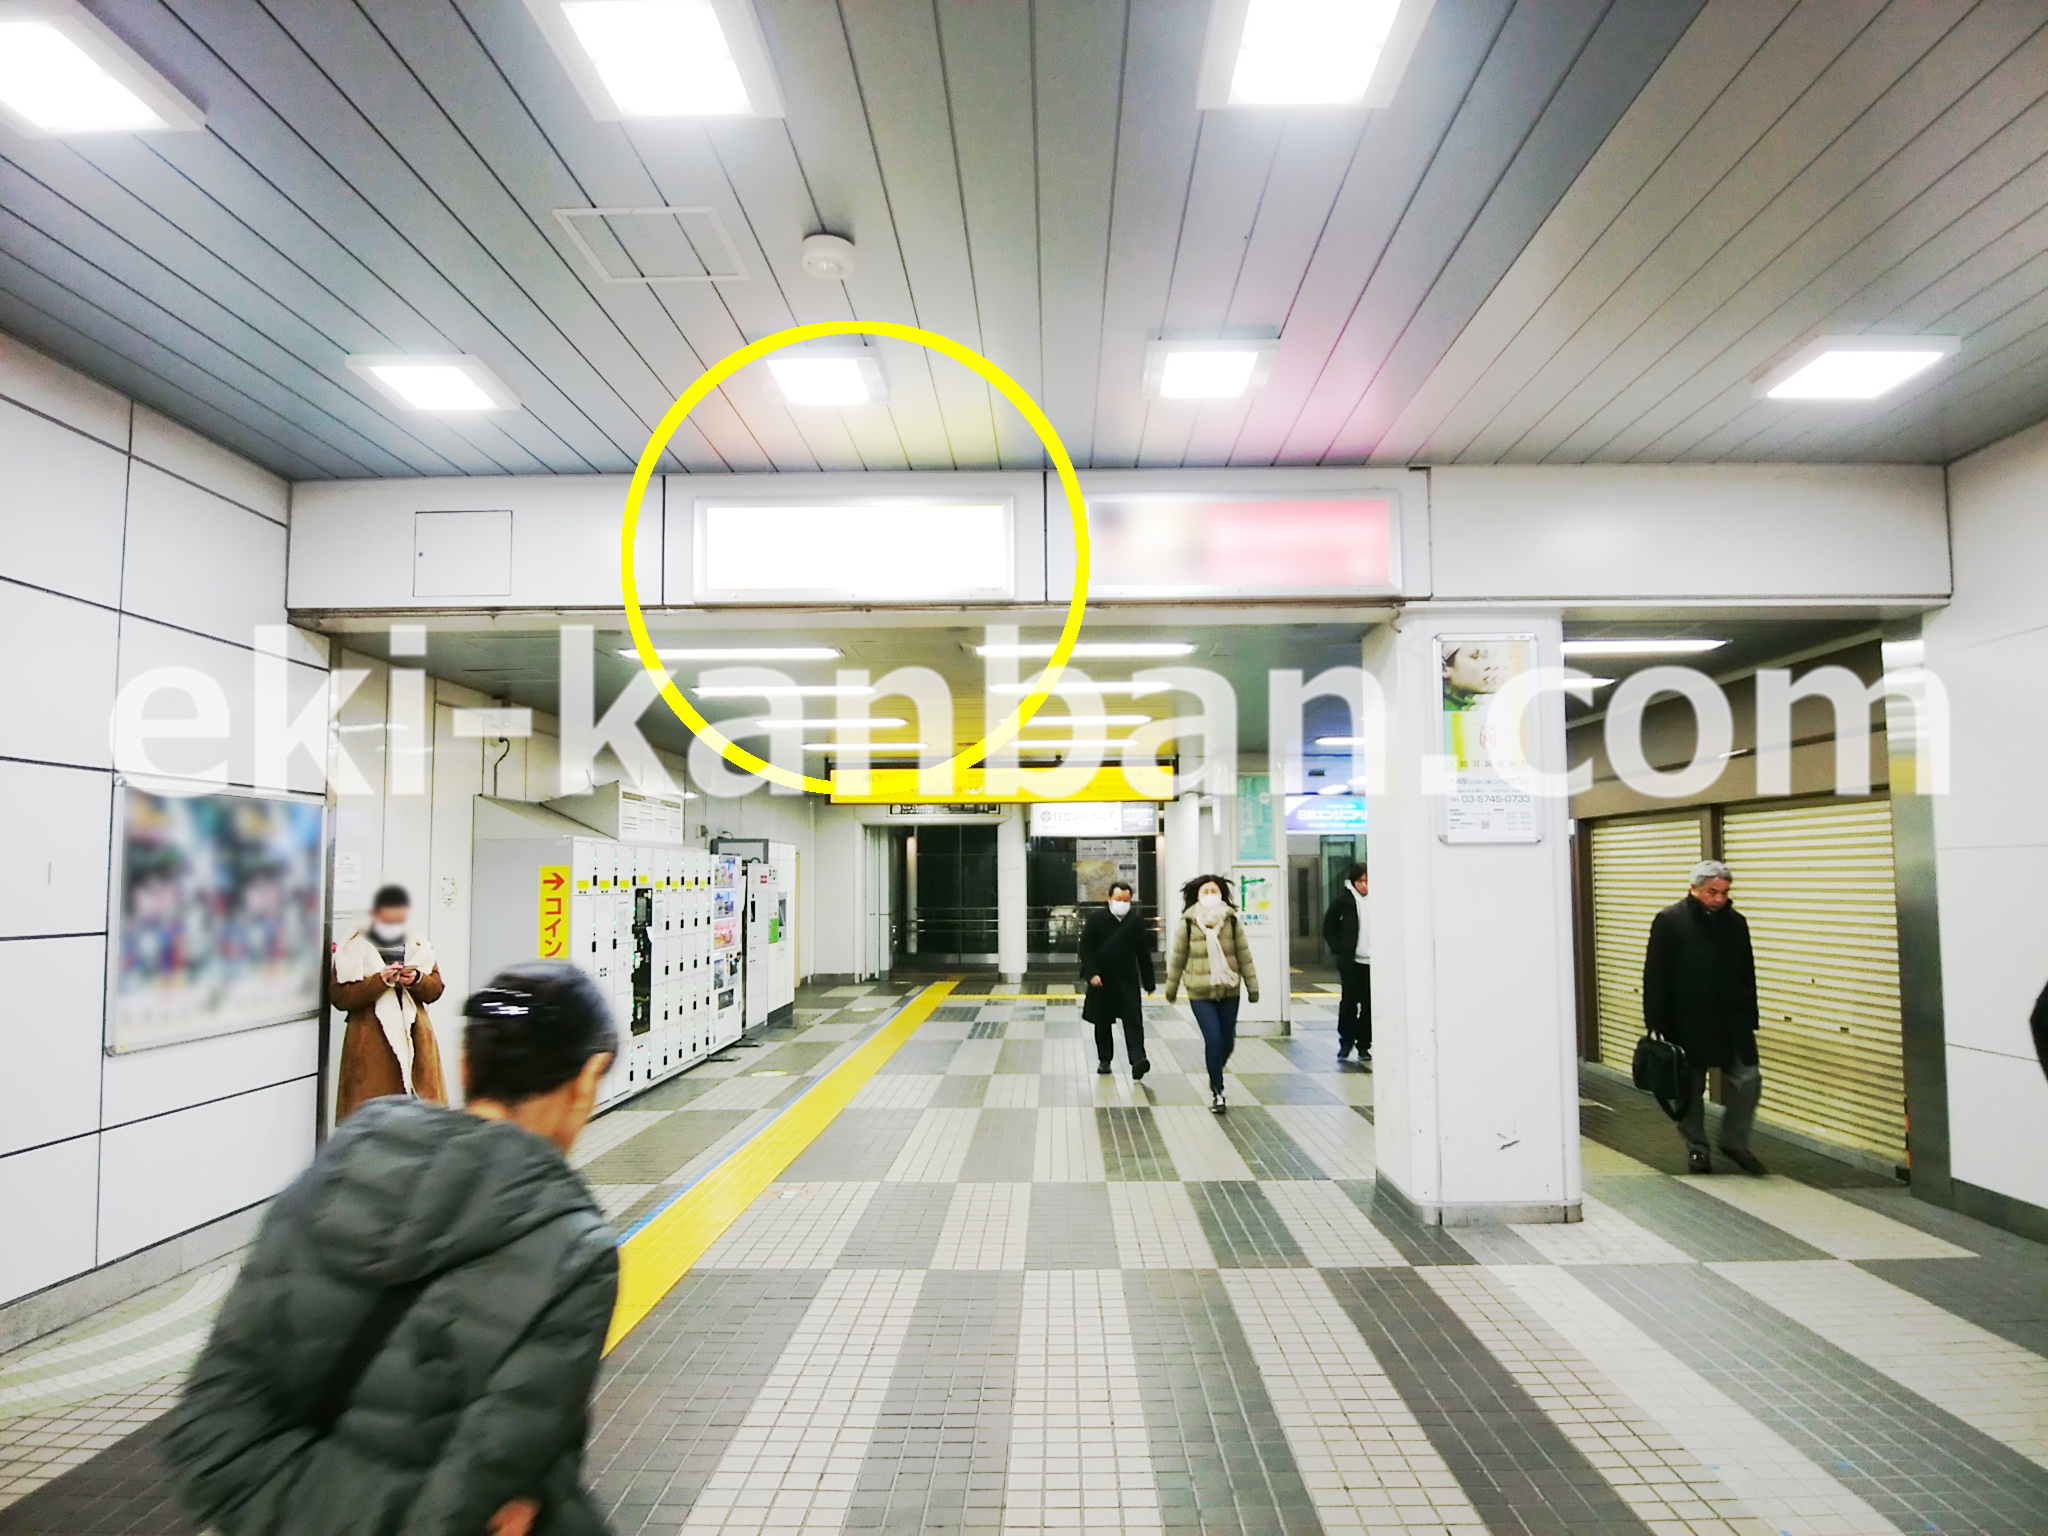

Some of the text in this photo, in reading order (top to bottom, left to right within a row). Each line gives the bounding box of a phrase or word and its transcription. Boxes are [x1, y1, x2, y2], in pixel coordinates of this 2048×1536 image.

[1461, 794, 1531, 803] 03-5745-0733
[1297, 809, 1367, 820] 日エンジニアリ
[545, 897, 562, 958] コイン
